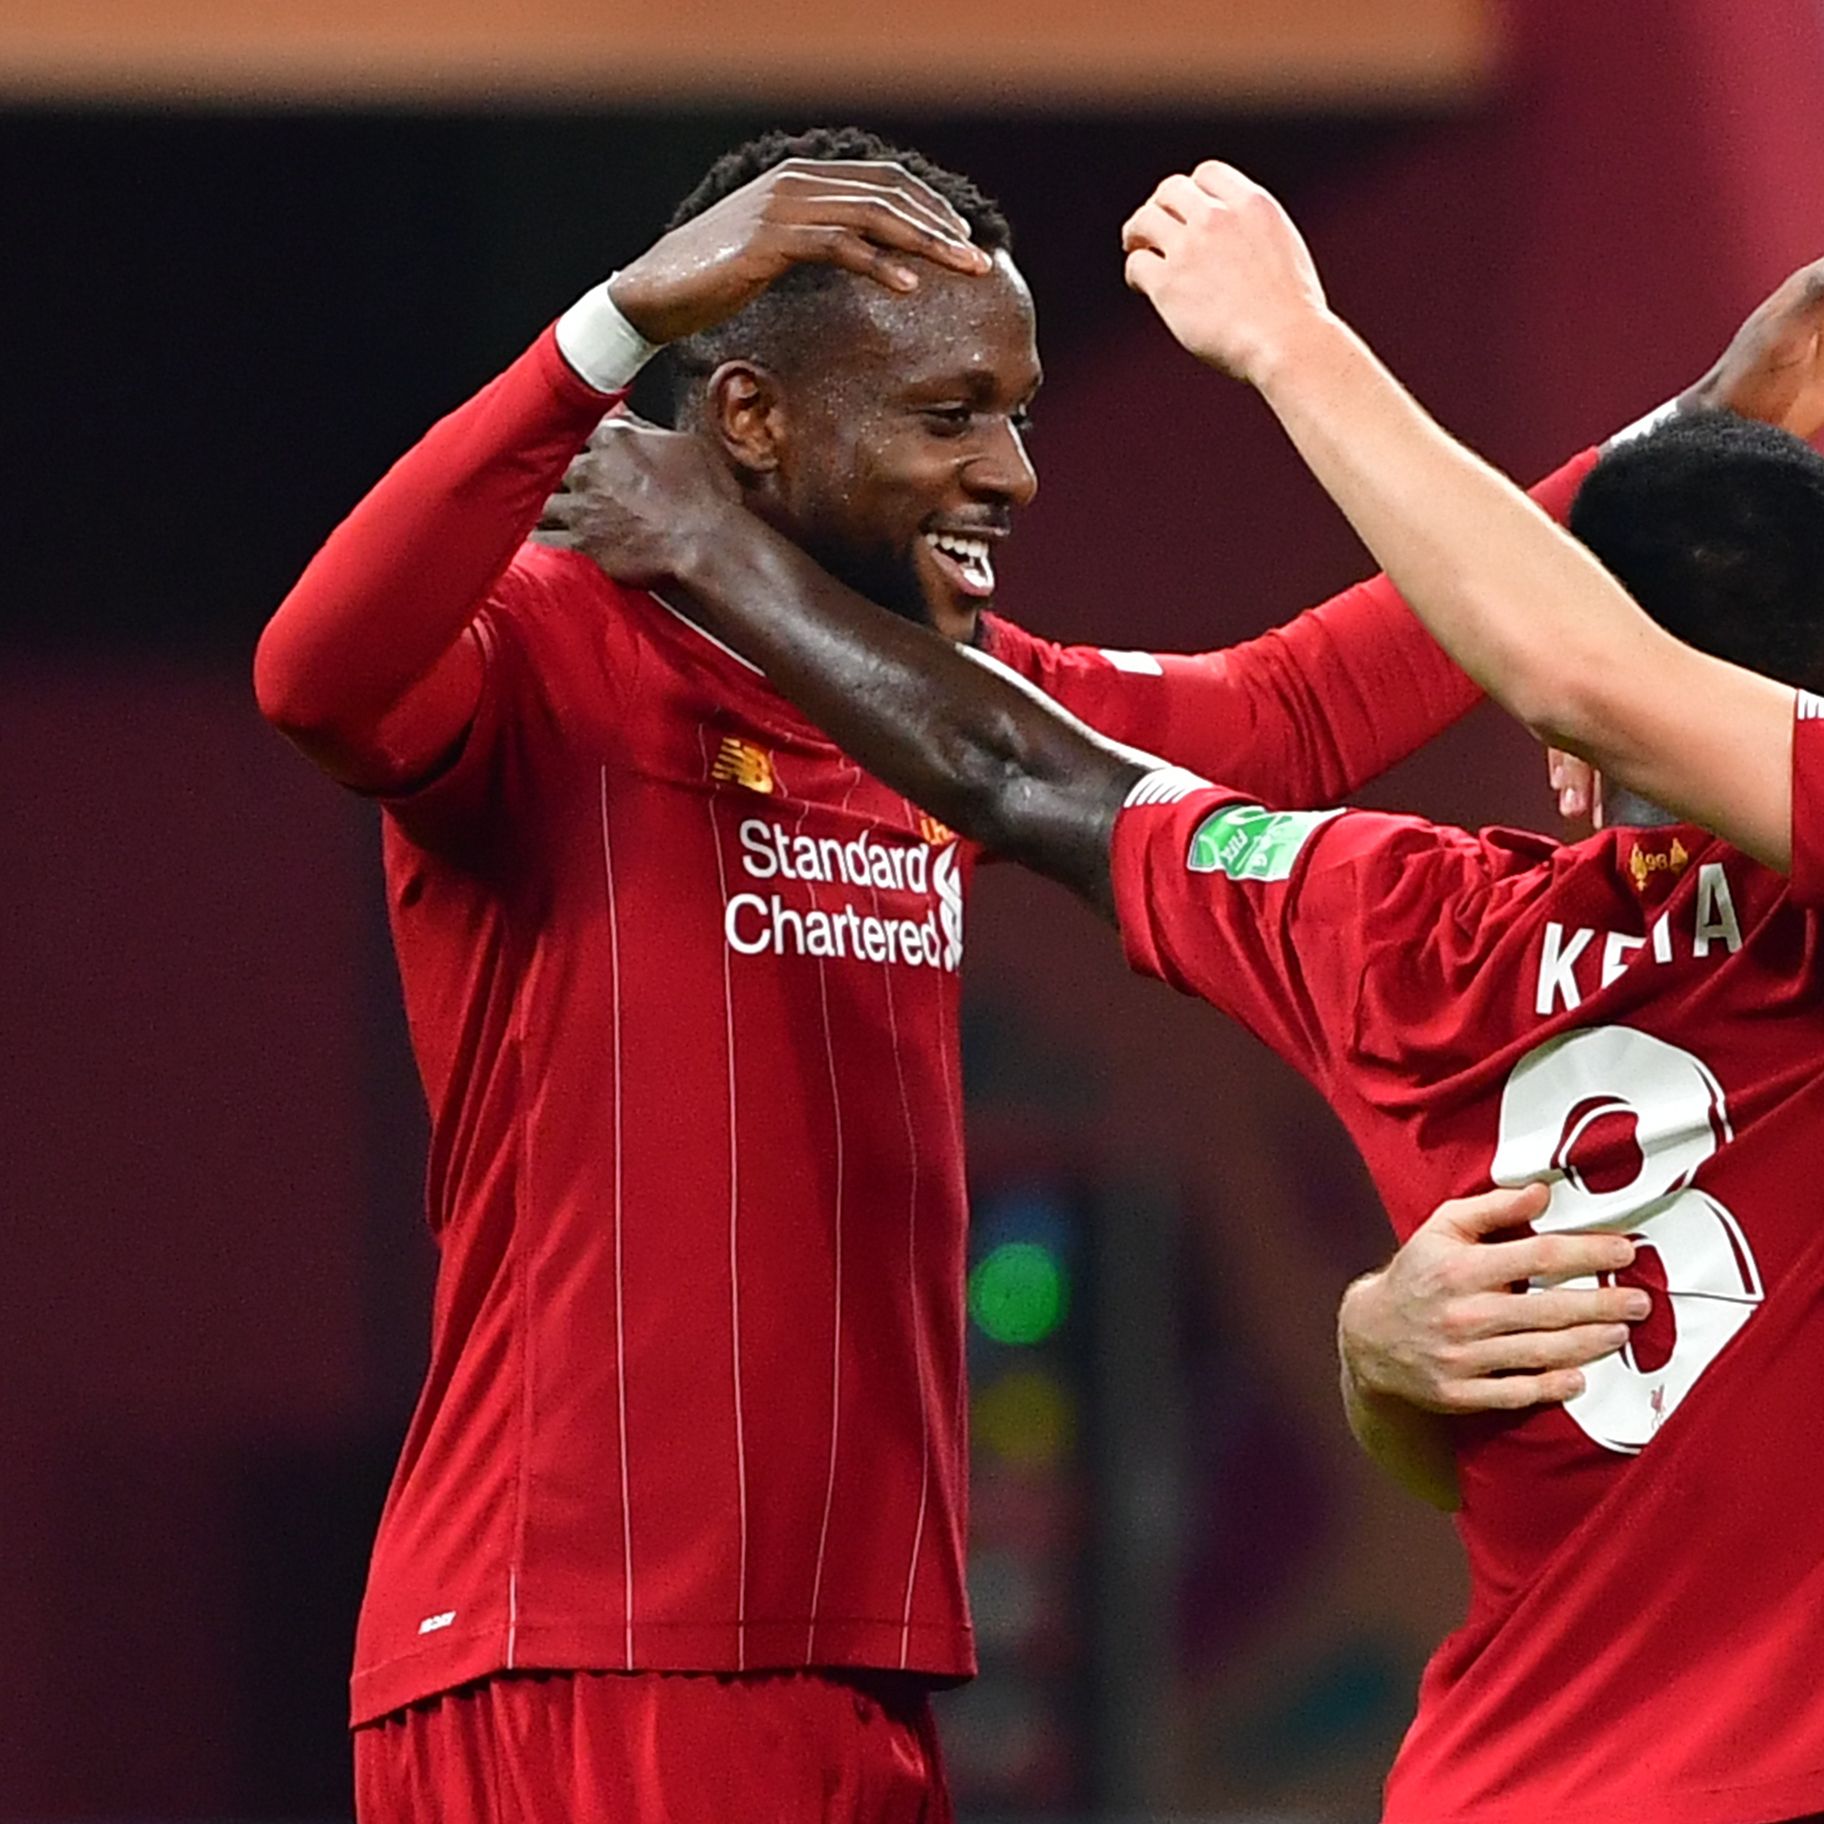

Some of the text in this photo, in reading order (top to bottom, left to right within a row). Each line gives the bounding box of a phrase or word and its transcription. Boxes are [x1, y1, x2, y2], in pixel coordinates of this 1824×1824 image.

[739, 818, 930, 894] Standard
[724, 892, 942, 969] Chartered
[1490, 1024, 1766, 1455] 8
